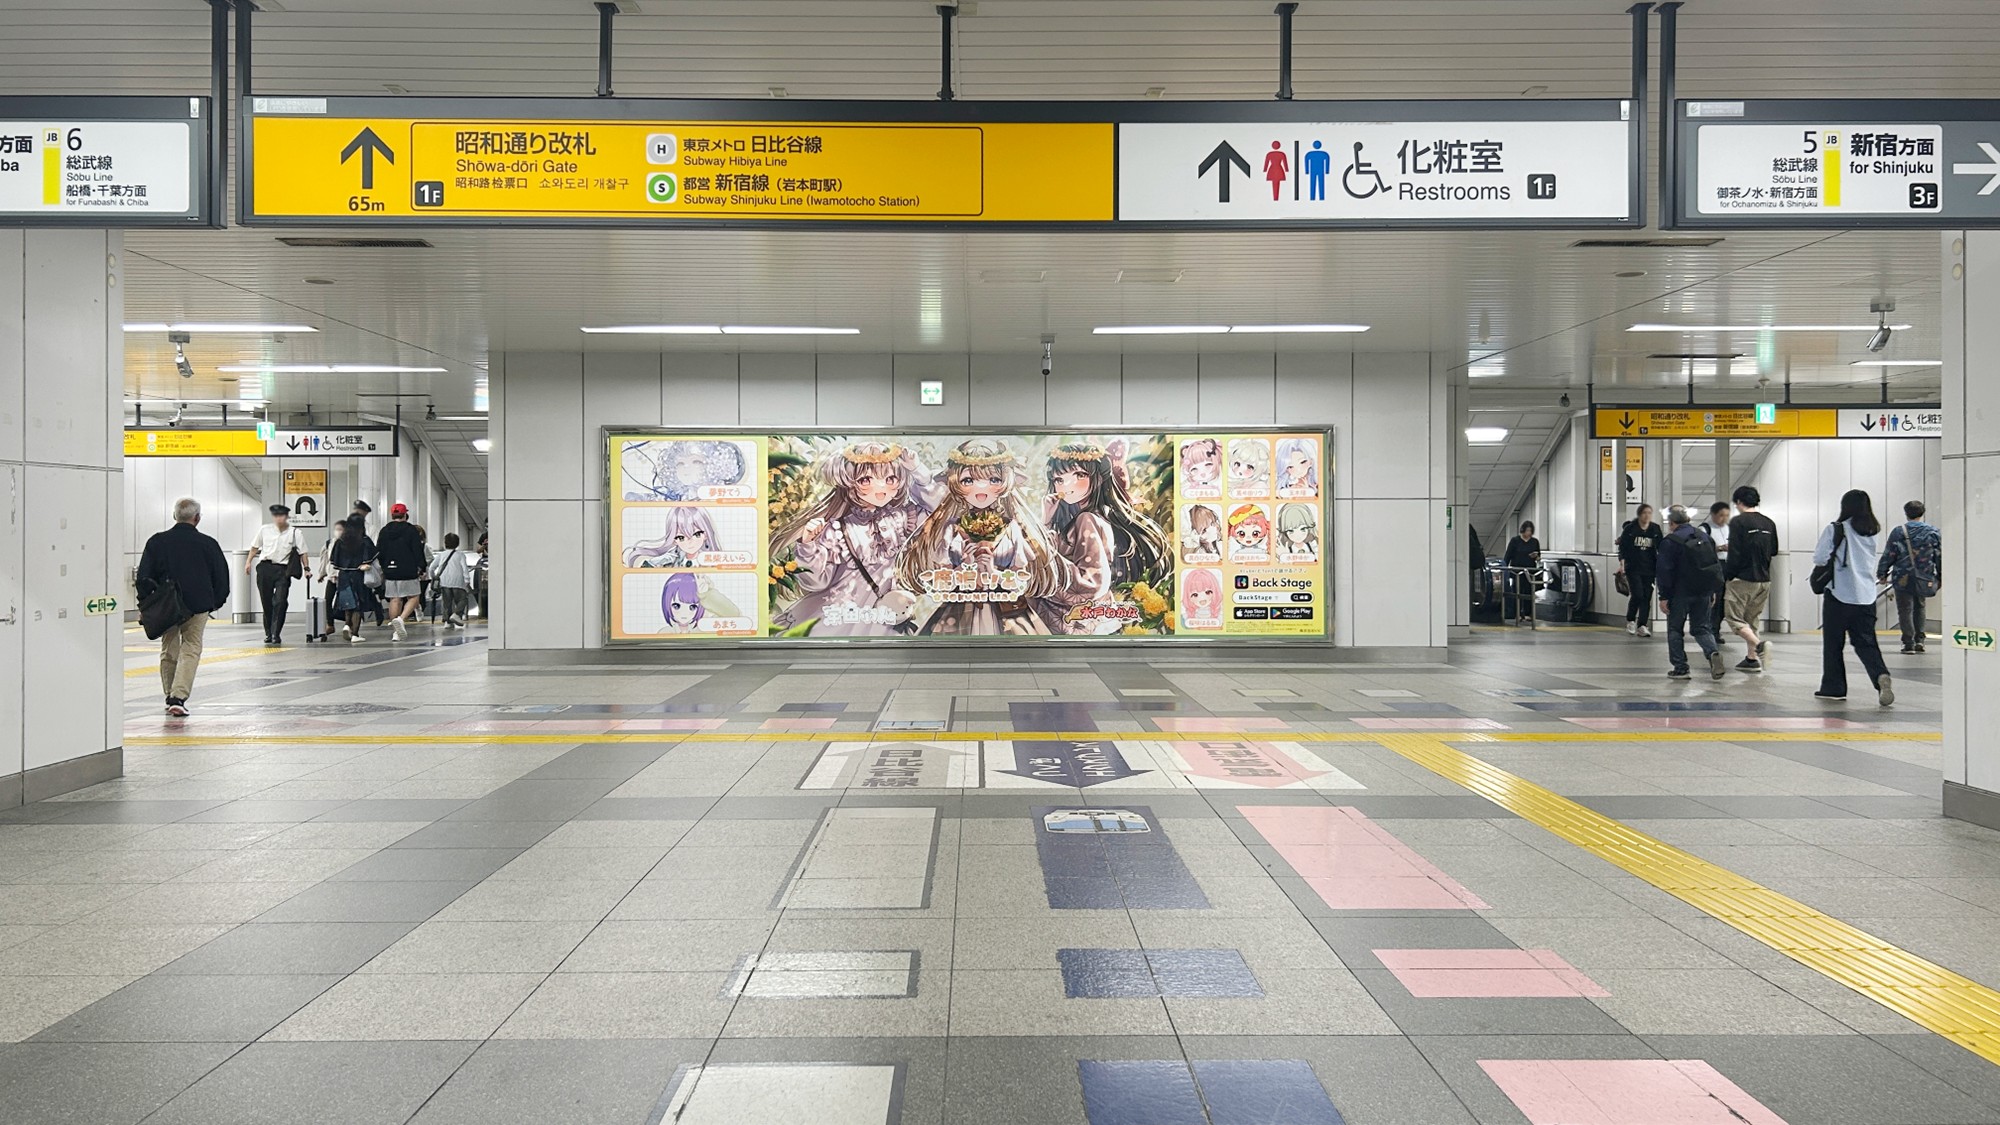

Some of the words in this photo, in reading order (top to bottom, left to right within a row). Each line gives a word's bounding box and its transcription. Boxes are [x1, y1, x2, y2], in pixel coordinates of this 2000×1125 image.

[0, 135, 32, 153] 方面
[47, 133, 58, 142] JB
[67, 128, 82, 151] 6
[455, 131, 596, 155] 昭和通り改札
[684, 139, 745, 152] 東京メトロ
[751, 136, 822, 153] 日比谷線
[1804, 131, 1817, 154] 5
[1826, 135, 1838, 144] JB
[1850, 133, 1935, 157] 新宿方面
[658, 145, 667, 154] H
[1397, 140, 1504, 174] 化粧室
[66, 155, 113, 170] 総武線
[456, 158, 537, 173] Shōwa-dōri
[543, 159, 577, 173] Gate
[684, 156, 726, 168] Subway
[729, 156, 762, 168] Hibiya
[765, 157, 788, 167] Line
[1772, 158, 1818, 173] 総武線
[1850, 161, 1869, 174] for
[1873, 161, 1934, 177] Shinjuku
[94, 173, 114, 182] Line
[539, 178, 589, 190] 소와도리
[593, 178, 630, 190] 개찰구
[684, 178, 710, 191] 都営
[715, 174, 769, 192] 新宿線
[1798, 175, 1818, 184] Line
[420, 185, 440, 203] 1F
[658, 185, 666, 194] S
[1400, 183, 1511, 201] Restrooms
[1532, 178, 1552, 195] 1F
[348, 196, 384, 211] 65m
[684, 194, 727, 206] Subway
[731, 195, 776, 206] Shinjuku
[781, 195, 804, 206] Line
[807, 195, 875, 206] (Iwamotocho
[879, 195, 920, 206] Station)
[1913, 187, 1935, 206] 3F
[1787, 200, 1818, 209] Shinjuku
[336, 435, 363, 445] 化粧室
[1252, 577, 1278, 588] Back
[1280, 577, 1312, 590] Stage
[1238, 594, 1272, 602] BackStage
[1080, 606, 1139, 620] 水戸わかな
[861, 749, 924, 787] 日比谷線
